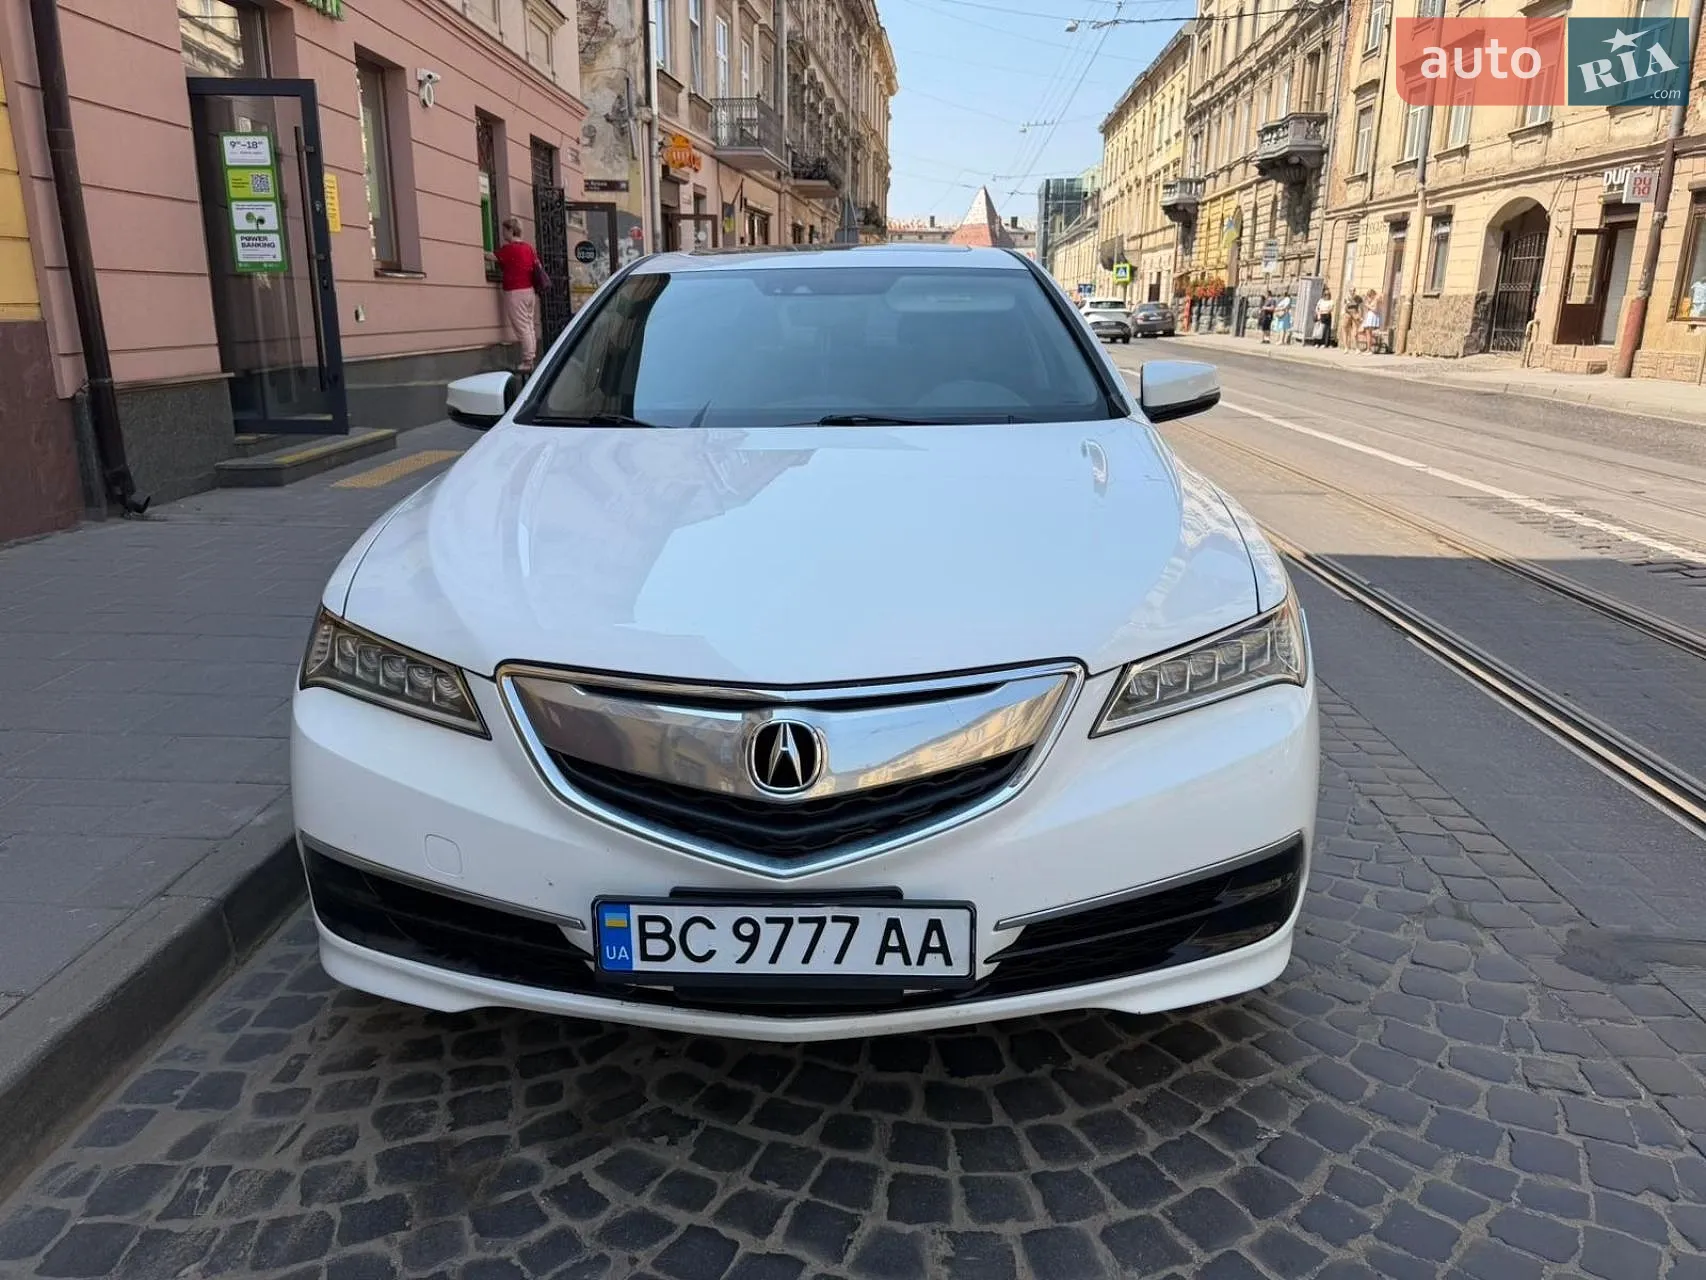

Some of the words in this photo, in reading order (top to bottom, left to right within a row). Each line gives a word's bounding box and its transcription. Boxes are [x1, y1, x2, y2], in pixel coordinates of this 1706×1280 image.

[605, 945, 630, 961] UA
[637, 914, 717, 963] BC
[732, 914, 861, 965] 9777
[875, 916, 953, 967] AA
